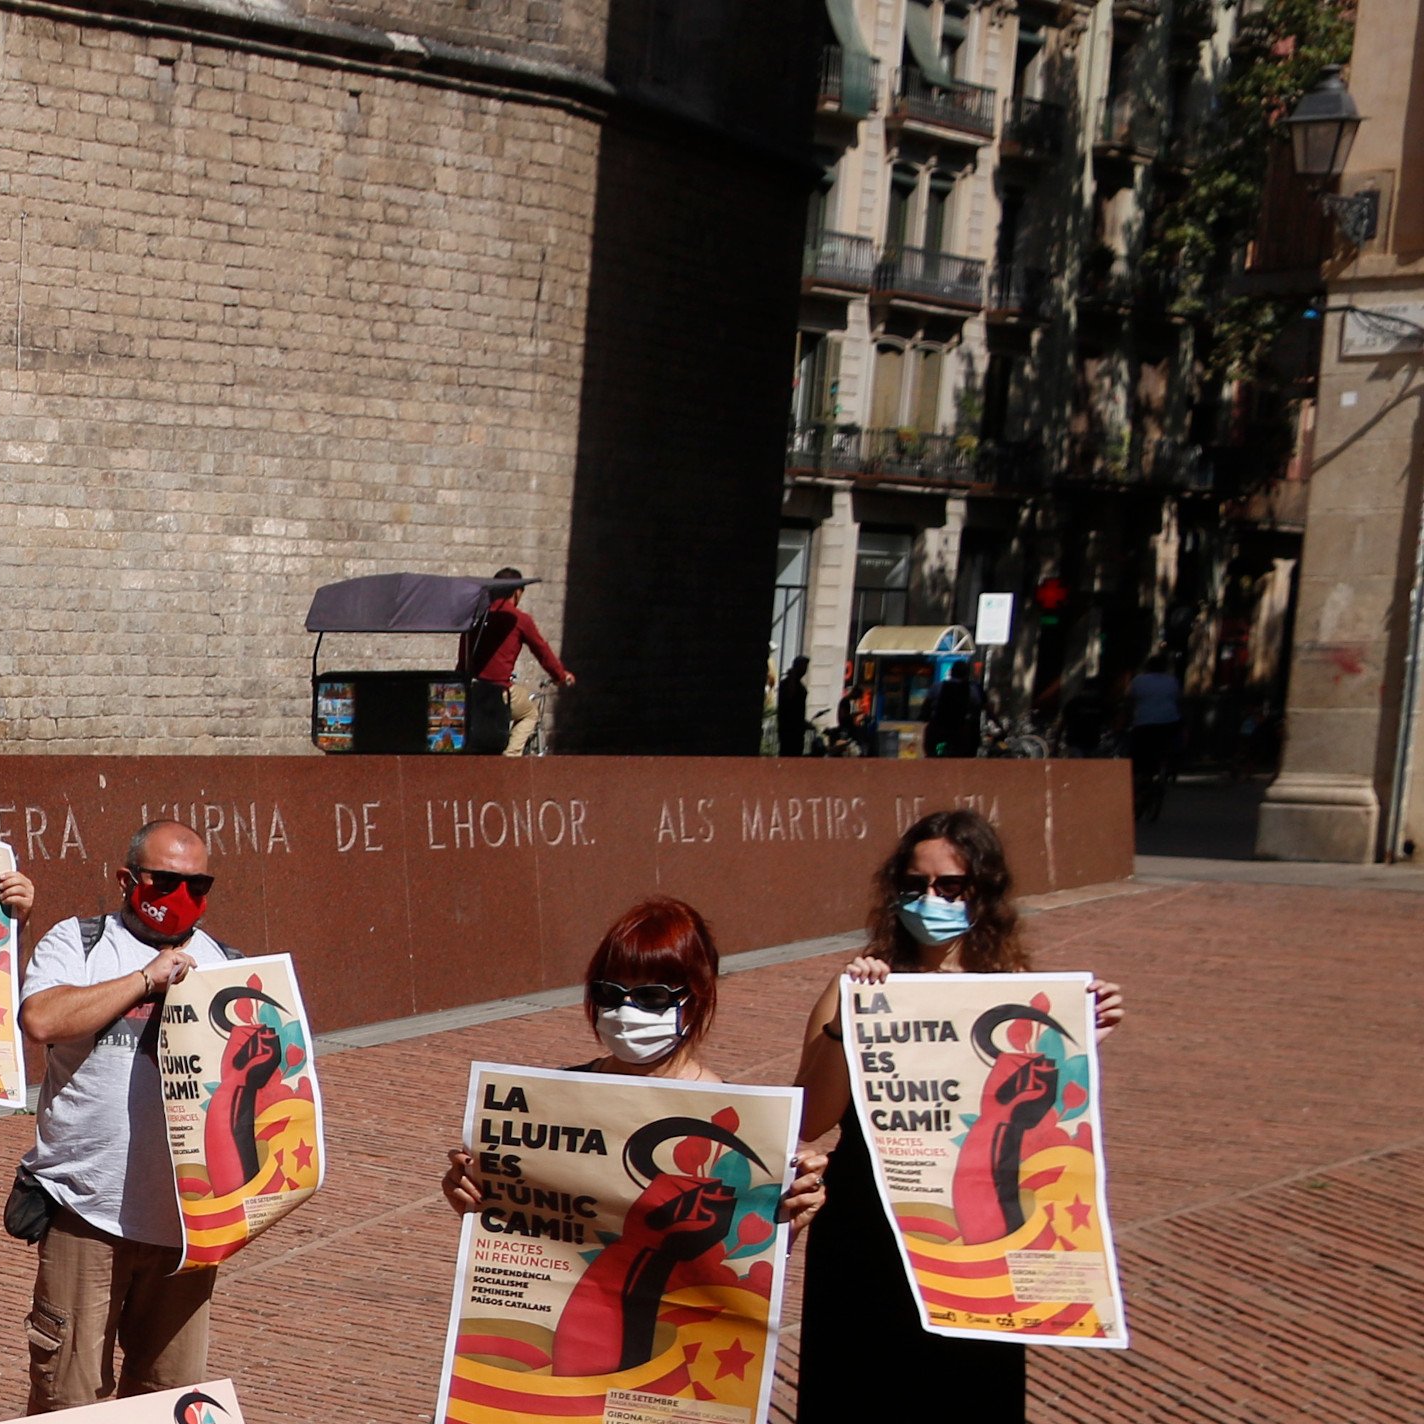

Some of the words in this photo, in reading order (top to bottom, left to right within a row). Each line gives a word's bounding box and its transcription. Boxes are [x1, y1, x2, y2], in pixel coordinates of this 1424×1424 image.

[334, 800, 384, 852] DE
[427, 799, 597, 850] L'HONOR.
[657, 798, 714, 843] ALS
[854, 992, 892, 1014] LA
[856, 1020, 959, 1044] LLUITA
[860, 1044, 895, 1073] ÉS
[483, 1083, 529, 1113] LA
[865, 1073, 960, 1102] L'ÚNIC
[870, 1101, 952, 1131] CAMÍ!
[480, 1119, 608, 1156] LLUITA
[886, 1137, 923, 1147] PACTES
[479, 1143, 522, 1178] ÉS
[482, 1178, 598, 1220] L'ÚNIC
[479, 1207, 585, 1246] CAMÍ!
[476, 1238, 490, 1249] NI
[492, 1240, 543, 1255] PACTES
[474, 1250, 489, 1261] NI
[491, 1252, 573, 1273] RENÚNCIES,
[474, 1266, 552, 1281] INDEPENDÈNCIA
[472, 1286, 524, 1298] FEMINISME
[473, 1276, 529, 1289] SOCIALISME
[470, 1295, 503, 1306] PAÏSOS
[504, 1299, 552, 1312] CATALANS
